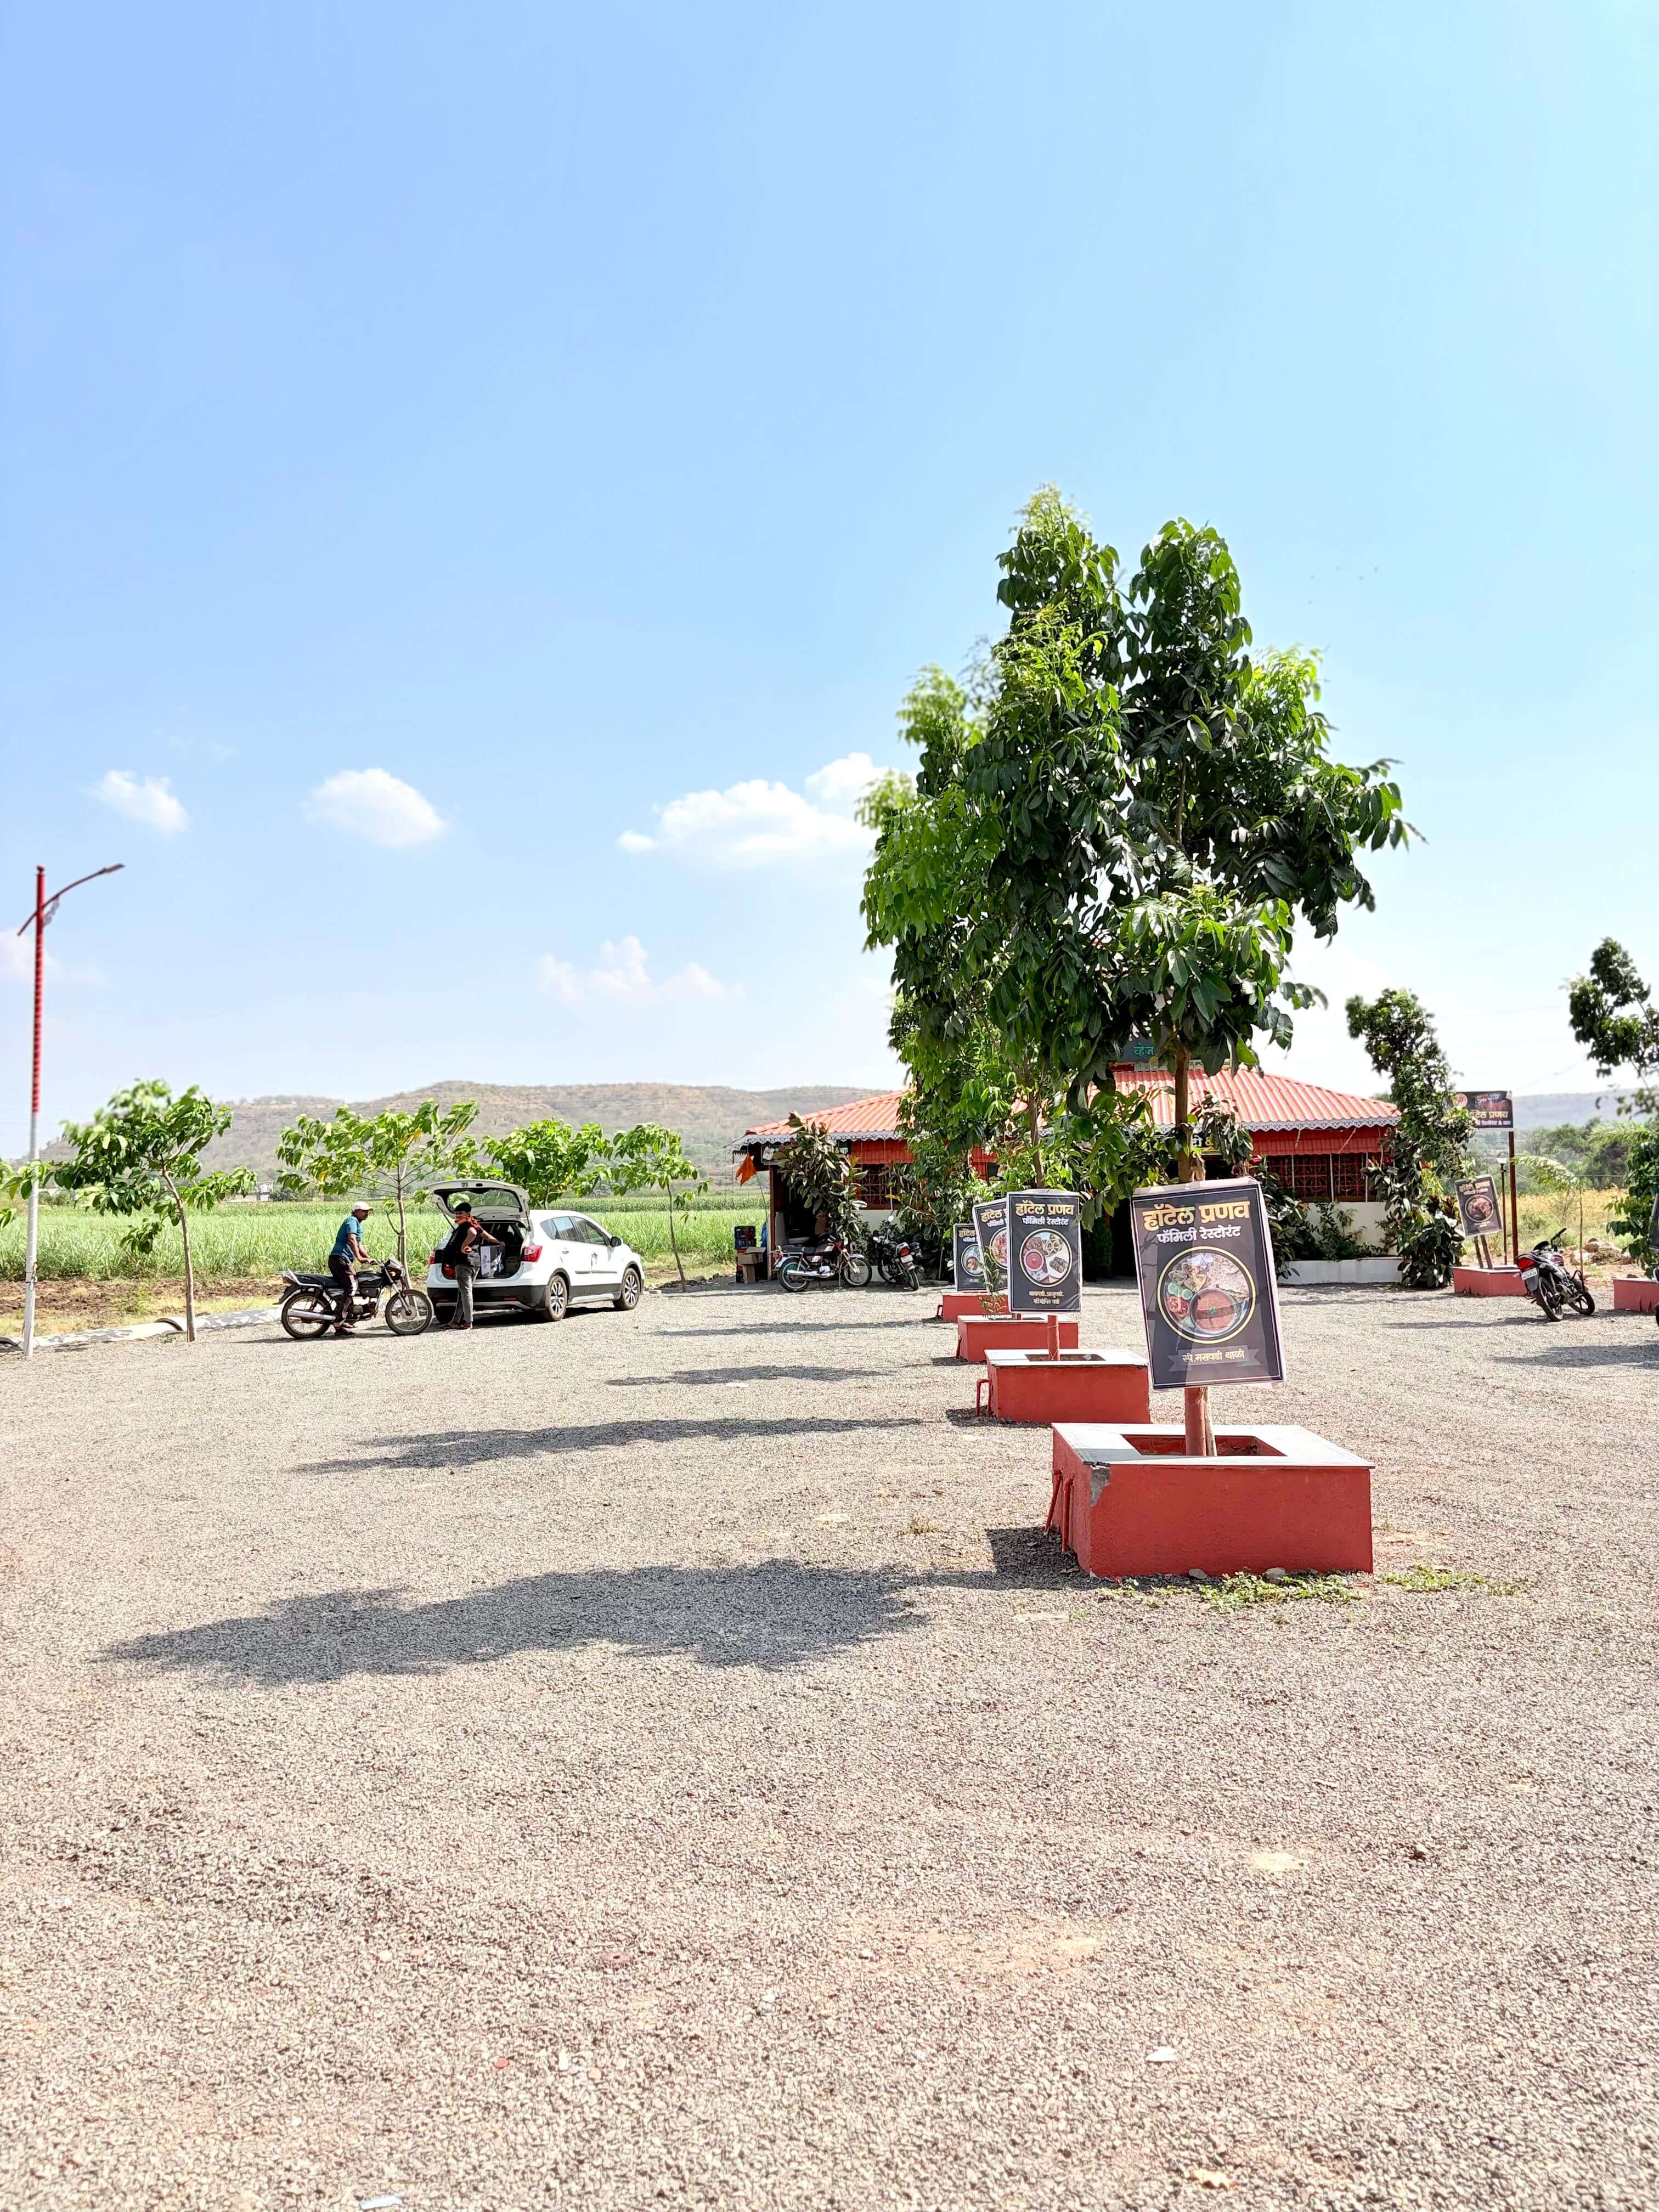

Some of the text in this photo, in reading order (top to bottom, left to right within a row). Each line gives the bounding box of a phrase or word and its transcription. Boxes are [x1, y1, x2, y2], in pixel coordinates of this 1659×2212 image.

[1133, 1042, 1154, 1057] व्हेज
[1015, 1200, 1045, 1216] हॉटेल
[1047, 1204, 1075, 1216] प्रणव
[980, 1209, 1002, 1223] हॉटेल
[1046, 1217, 1070, 1226] रेस्टोरंट
[1142, 1201, 1250, 1231] हॉटेल प्रणव
[958, 1228, 975, 1238] हॉटेल
[1156, 1224, 1241, 1243] फॅमिली रेस्टोरंट
[1224, 1348, 1245, 1359] थाळी
